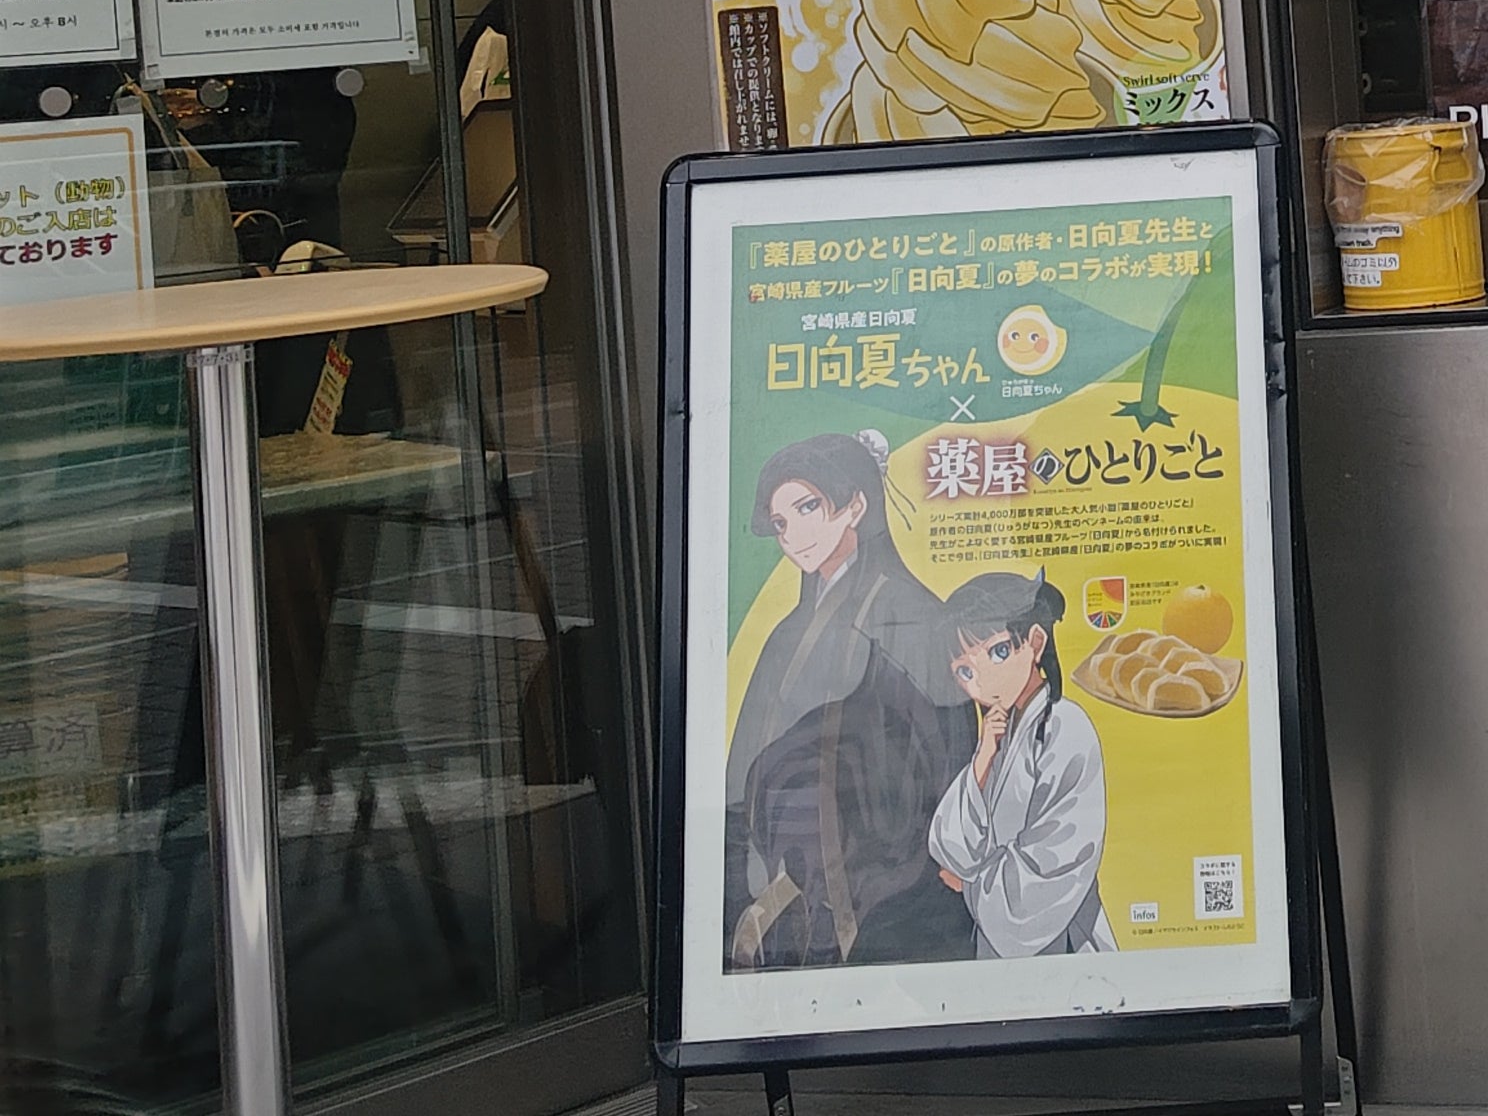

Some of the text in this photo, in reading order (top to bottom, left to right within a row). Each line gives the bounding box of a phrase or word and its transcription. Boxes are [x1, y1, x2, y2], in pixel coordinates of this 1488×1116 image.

[1123, 74, 1153, 86] Swirl
[1156, 72, 1177, 84] soft
[1123, 88, 1215, 116] ミックス
[0, 232, 118, 265] ております
[749, 216, 1214, 270] 『薬屋のひとりごと』の原作者・日向夏先生と
[801, 307, 917, 332] 宮崎県産日向夏
[767, 334, 991, 391] 日向夏ちゃん
[925, 428, 1226, 501] 薬屋のひとりごと
